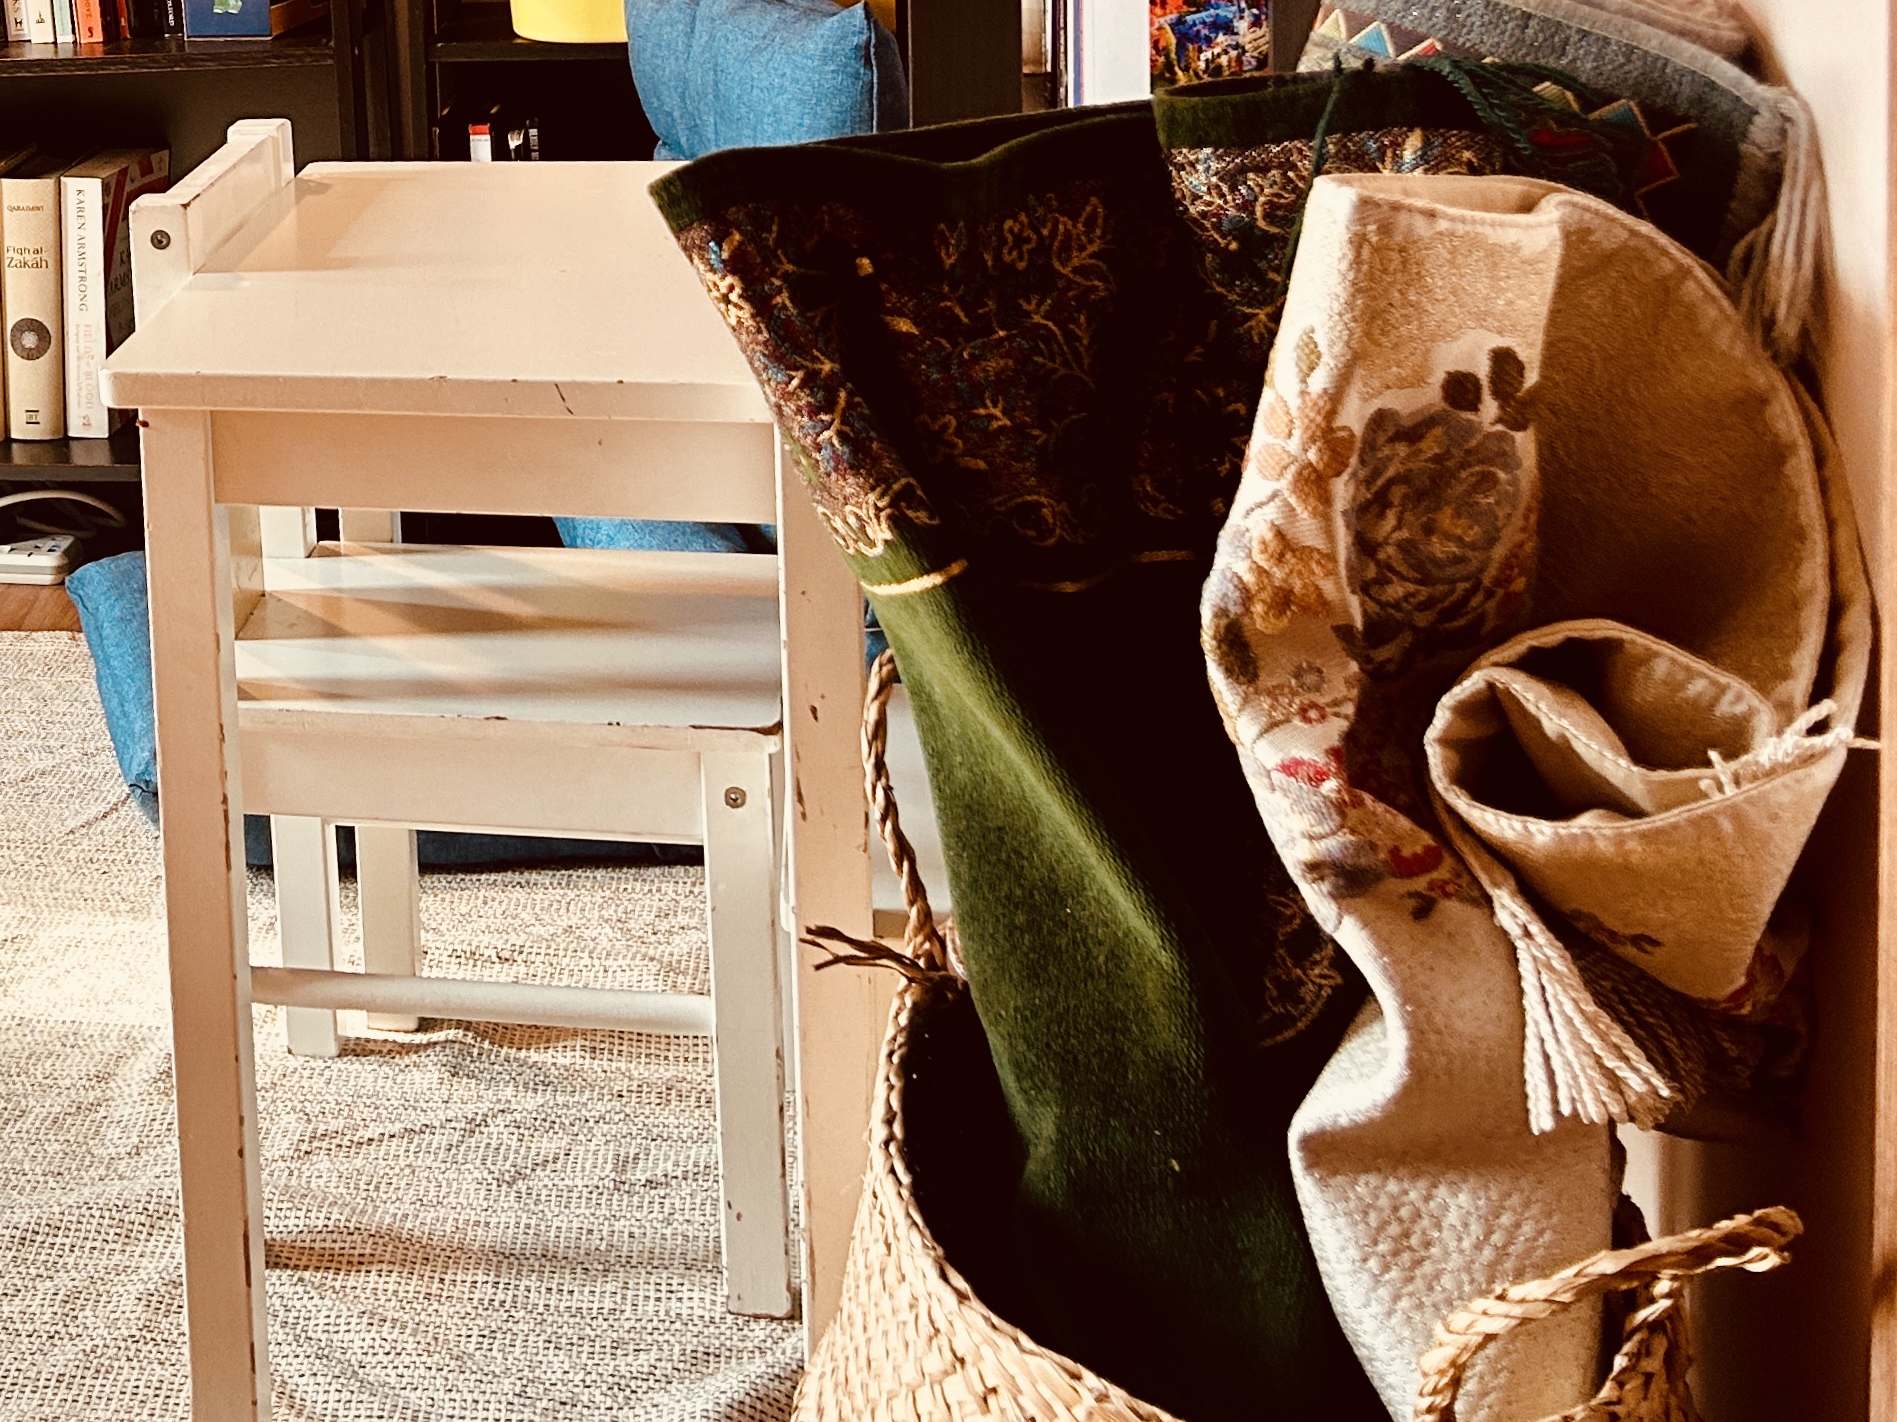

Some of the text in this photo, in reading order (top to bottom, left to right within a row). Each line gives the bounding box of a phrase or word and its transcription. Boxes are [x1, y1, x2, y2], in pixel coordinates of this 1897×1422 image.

[5, 245, 31, 255] Fiqh
[75, 189, 89, 312] KAREN ARMSTRONG
